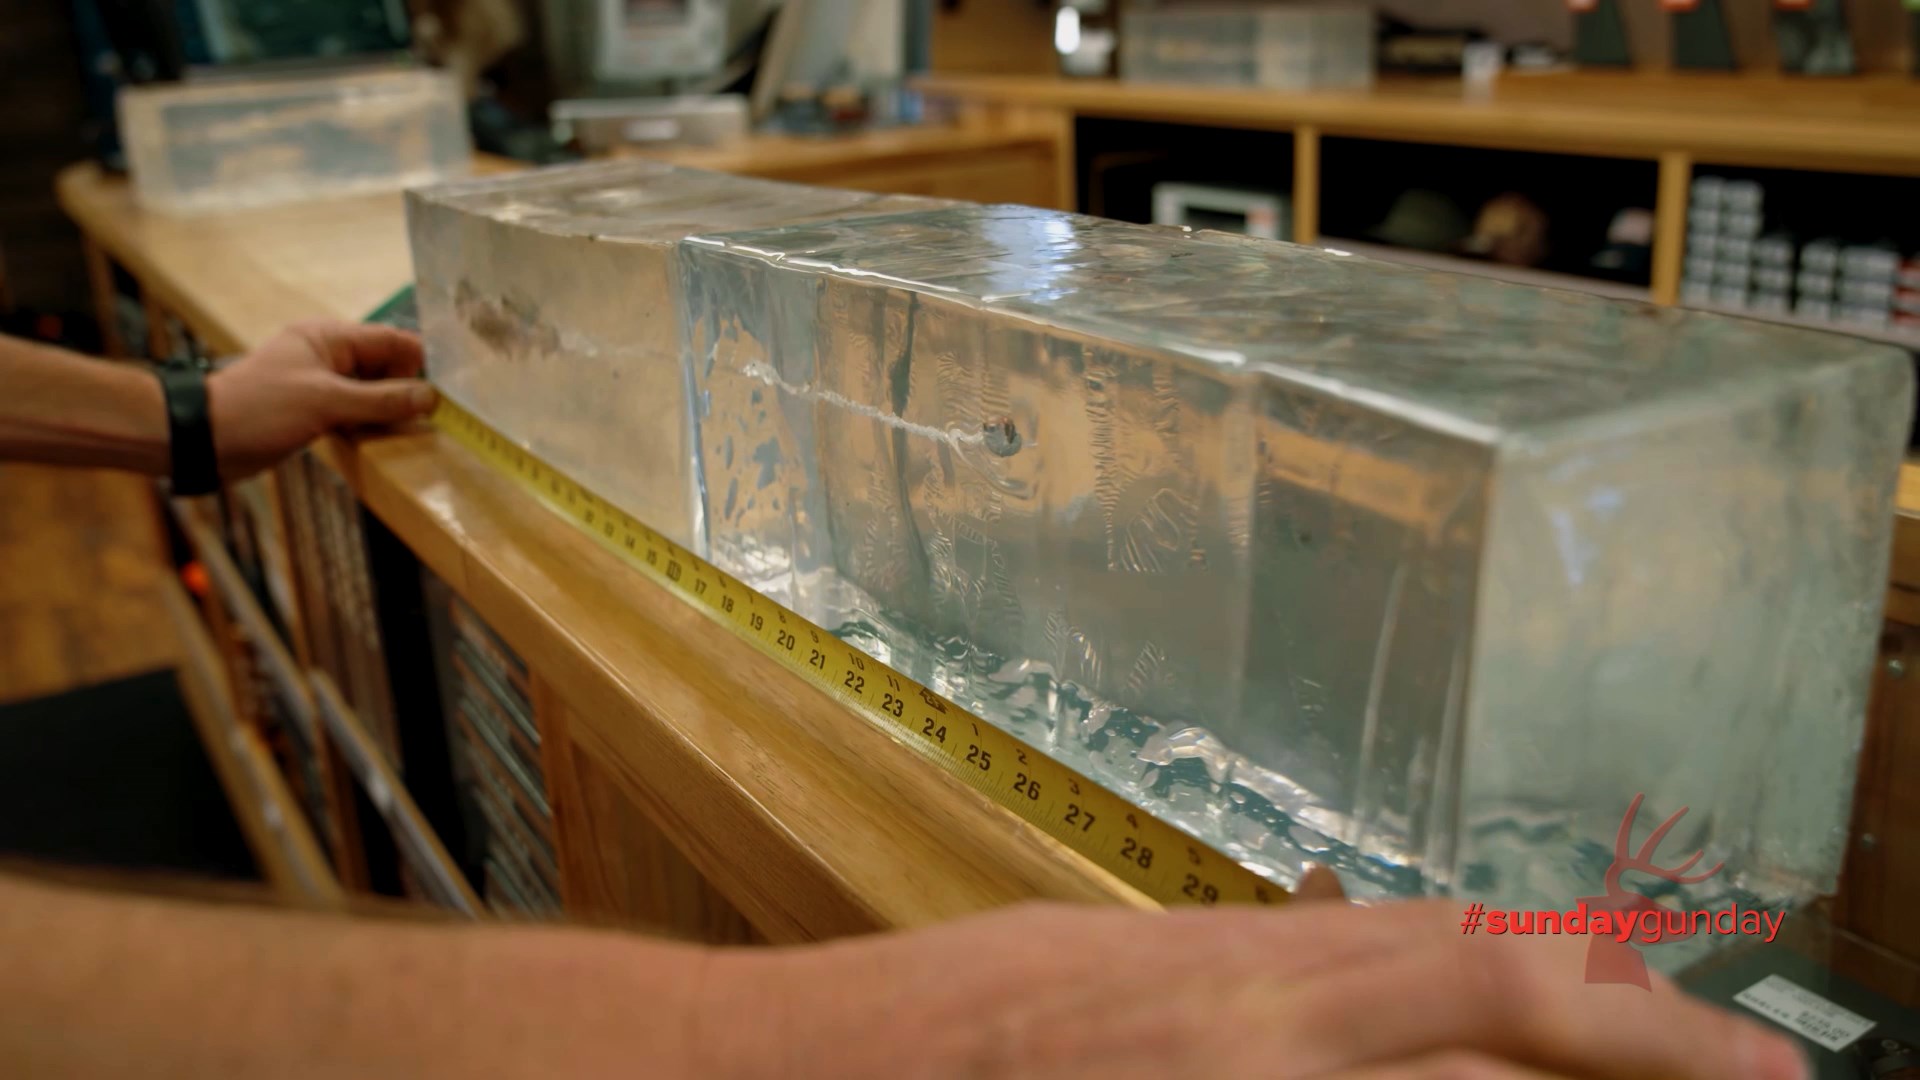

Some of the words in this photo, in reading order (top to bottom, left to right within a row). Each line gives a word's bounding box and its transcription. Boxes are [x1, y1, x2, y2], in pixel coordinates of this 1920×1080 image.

[695, 578, 707, 595] 17
[721, 595, 734, 613] 18
[750, 613, 764, 631] 19
[777, 630, 795, 650] 20
[809, 649, 825, 670] 21
[844, 671, 865, 694] 22
[882, 693, 904, 718] 23
[922, 717, 947, 744] 24
[966, 744, 991, 771] 25
[1013, 772, 1041, 800] 26
[1064, 803, 1096, 832] 27
[1121, 837, 1153, 868] 28
[1182, 873, 1218, 905] 29
[848, 653, 864, 671] 10
[887, 675, 900, 692] 11
